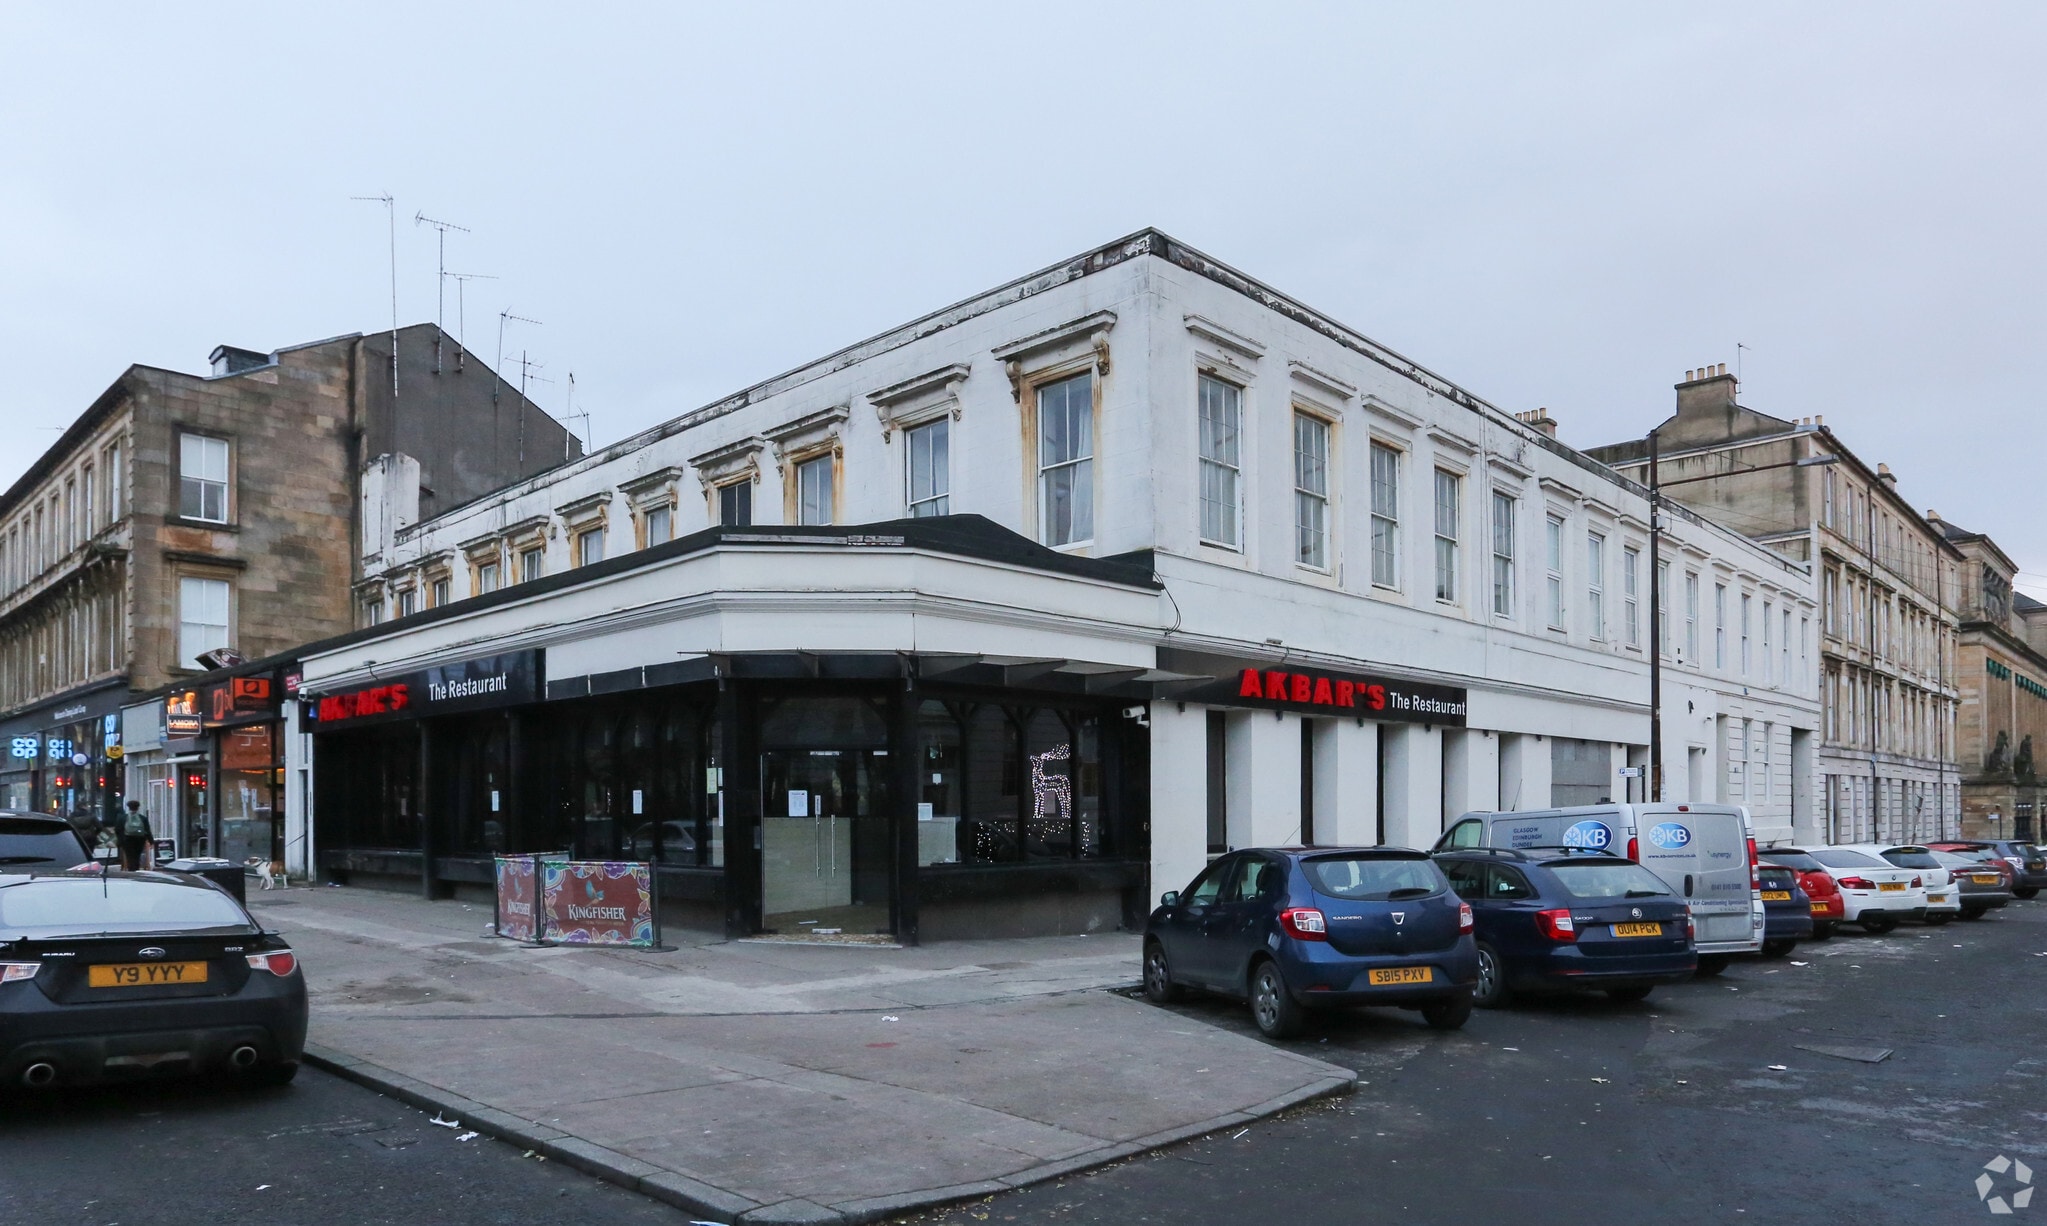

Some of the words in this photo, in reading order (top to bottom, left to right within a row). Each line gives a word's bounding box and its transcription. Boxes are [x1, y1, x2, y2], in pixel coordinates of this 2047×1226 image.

[429, 683, 446, 701] The
[449, 672, 507, 698] Restaurant
[1239, 668, 1385, 710] AKBAR'S
[1390, 692, 1410, 709] The
[1413, 694, 1466, 715] Restaurant
[1582, 828, 1606, 847] KB
[1666, 829, 1688, 843] KB
[568, 904, 626, 921] KINGFISHER
[1617, 925, 1638, 935] OU14
[113, 966, 139, 983] Y9
[146, 964, 186, 982] YYY
[1376, 970, 1401, 982] SB15
[1404, 968, 1425, 981] PXV
